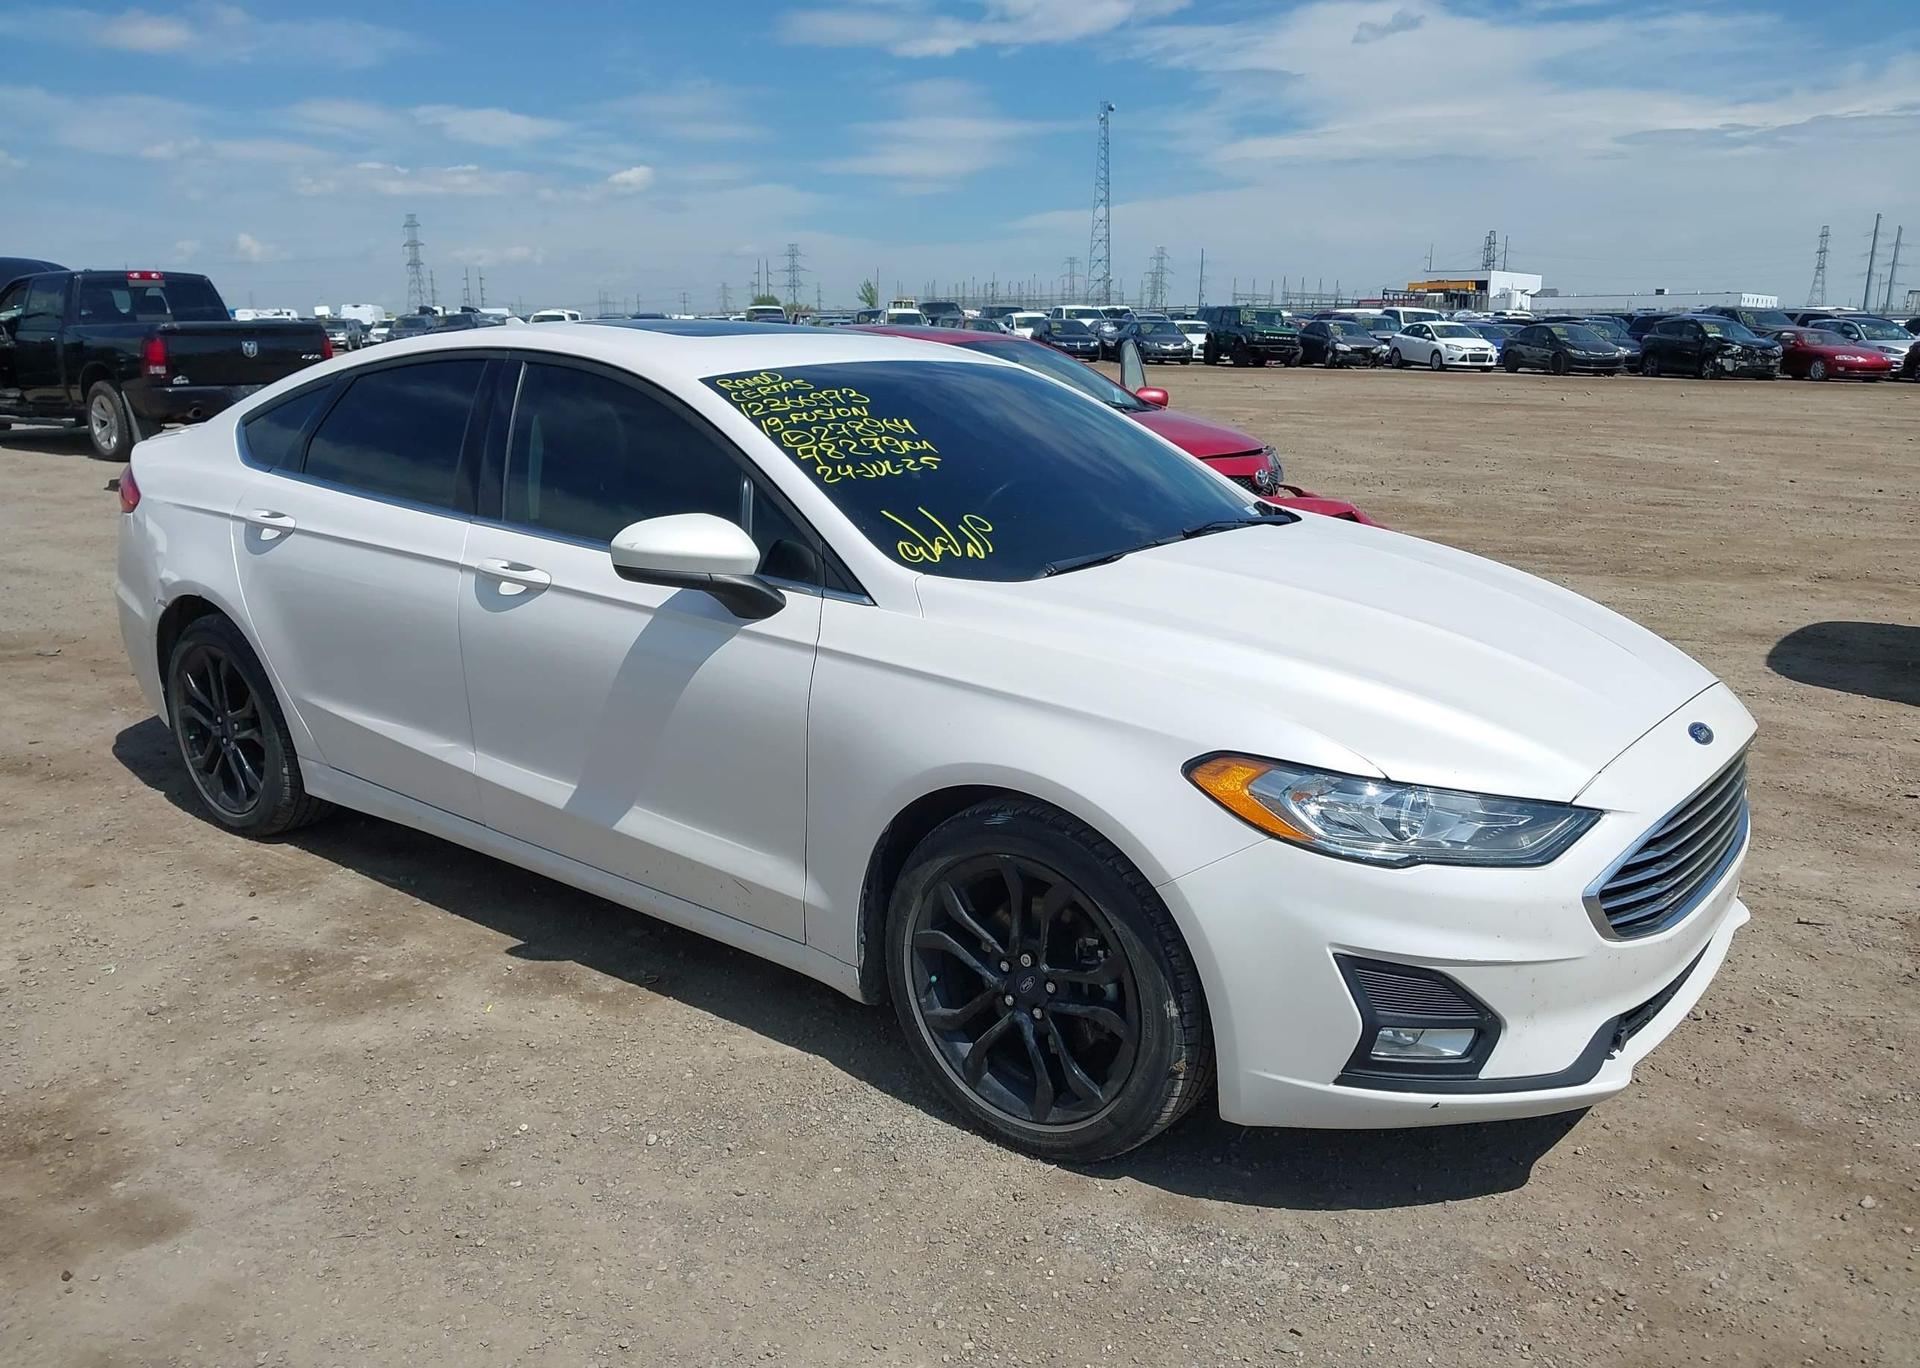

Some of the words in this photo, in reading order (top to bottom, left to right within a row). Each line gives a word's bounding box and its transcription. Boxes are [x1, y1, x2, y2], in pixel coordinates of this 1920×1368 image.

[740, 387, 870, 417] 12366973
[810, 418, 918, 442] 278964
[815, 456, 942, 483] 24-JUL-25
